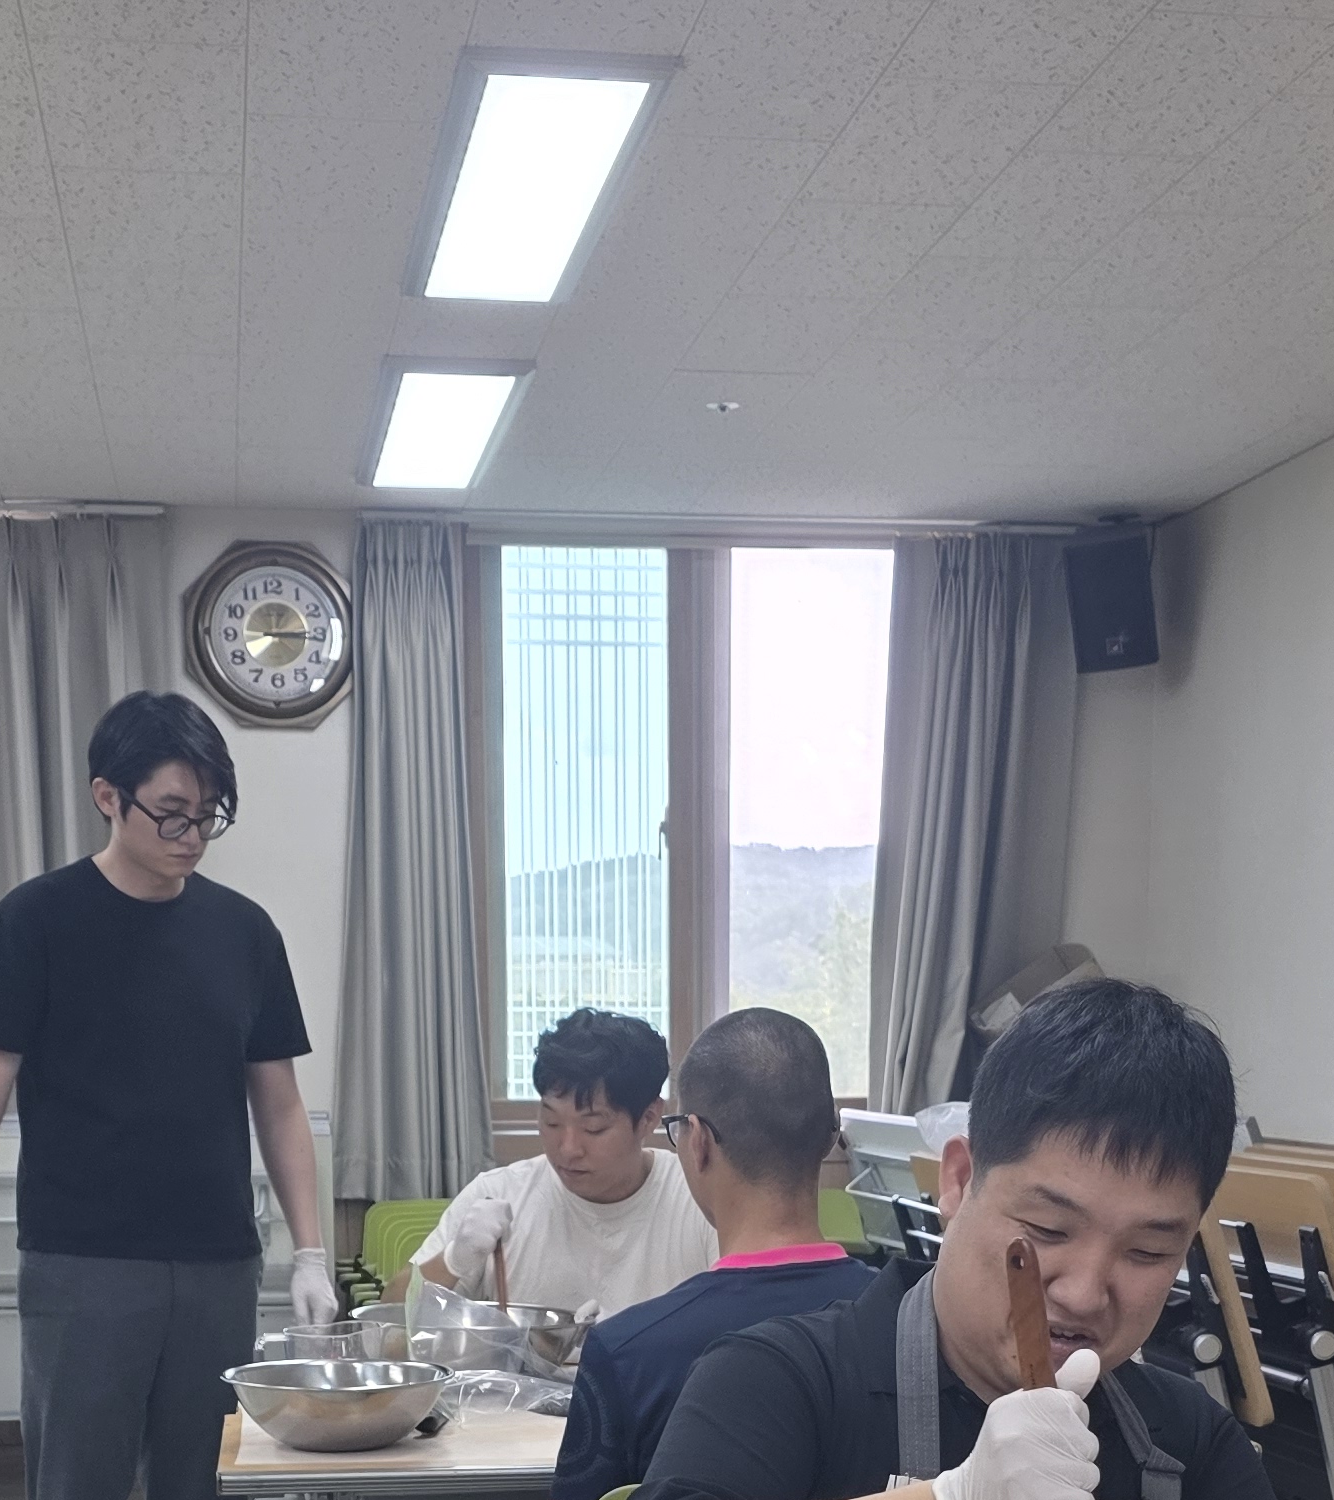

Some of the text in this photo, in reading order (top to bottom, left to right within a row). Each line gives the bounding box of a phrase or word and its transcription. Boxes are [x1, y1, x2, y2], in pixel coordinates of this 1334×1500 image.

[243, 583, 257, 601] 11
[263, 577, 283, 595] 12
[294, 586, 300, 602] 1
[226, 603, 245, 619] 10
[305, 602, 321, 618] 2
[223, 626, 238, 642] 9
[311, 627, 327, 642] 3
[230, 649, 246, 665] 8
[308, 650, 322, 664] 4
[249, 668, 263, 683] 7
[270, 672, 285, 689] 6
[293, 666, 308, 683] 5
